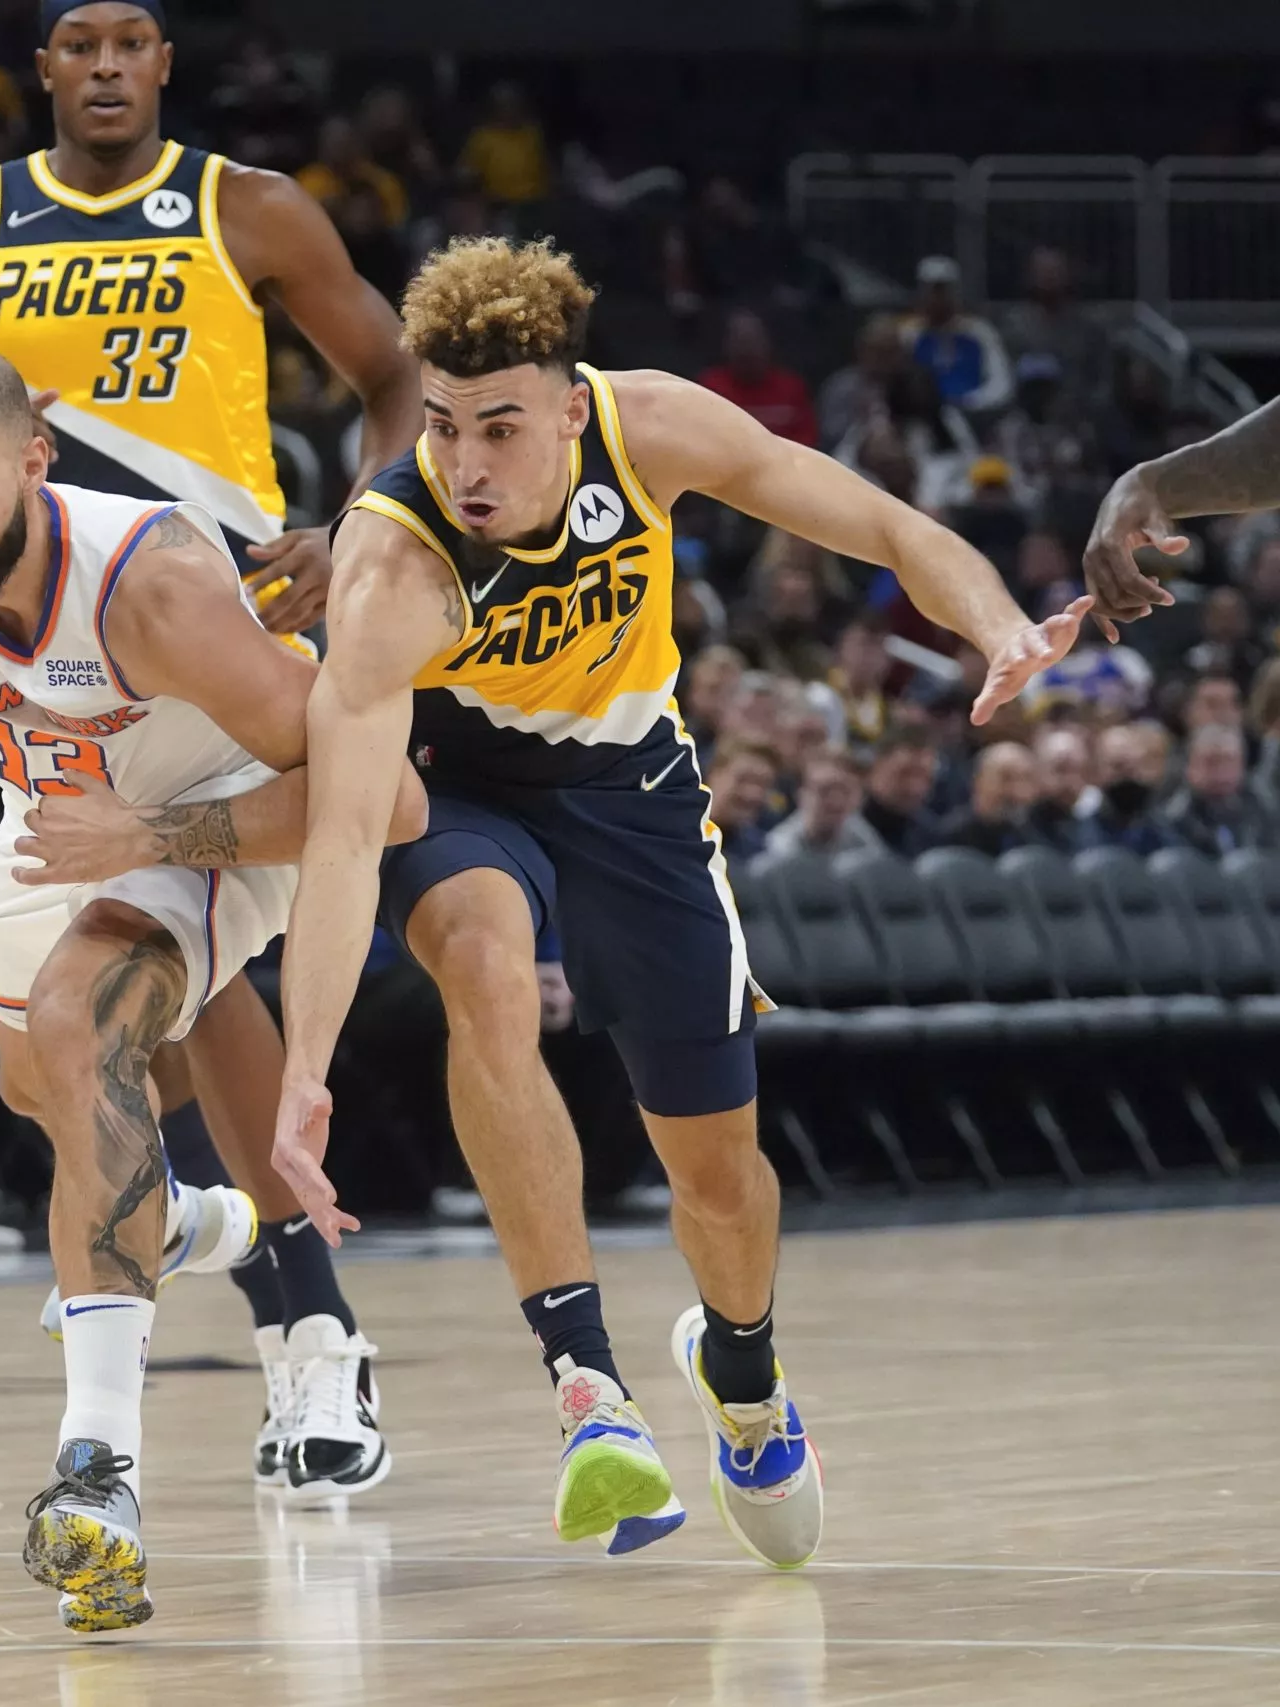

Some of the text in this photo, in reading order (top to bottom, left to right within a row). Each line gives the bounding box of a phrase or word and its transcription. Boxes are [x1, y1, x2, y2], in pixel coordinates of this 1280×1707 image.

[92, 326, 191, 404] 33
[45, 659, 103, 673] SQUARE
[47, 673, 96, 687] SPACE
[45, 704, 150, 738] RK
